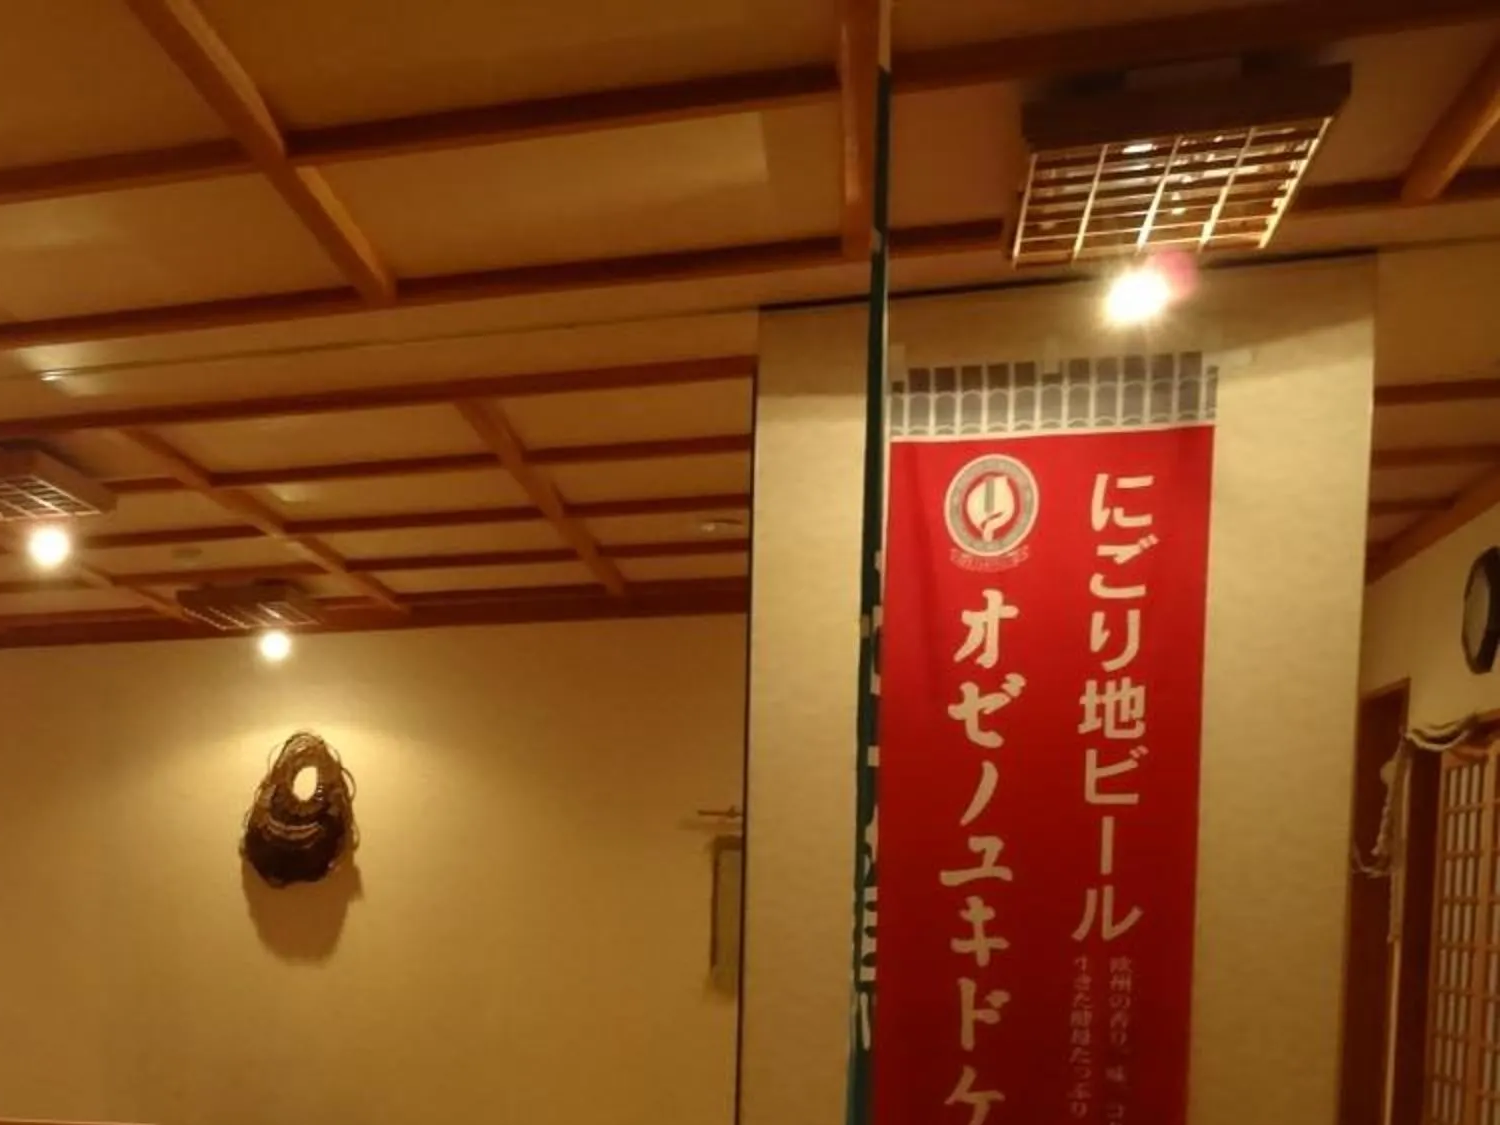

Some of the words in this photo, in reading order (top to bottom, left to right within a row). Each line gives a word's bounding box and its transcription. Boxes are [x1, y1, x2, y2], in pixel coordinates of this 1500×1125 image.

[1072, 472, 1159, 941] にごり地ビール
